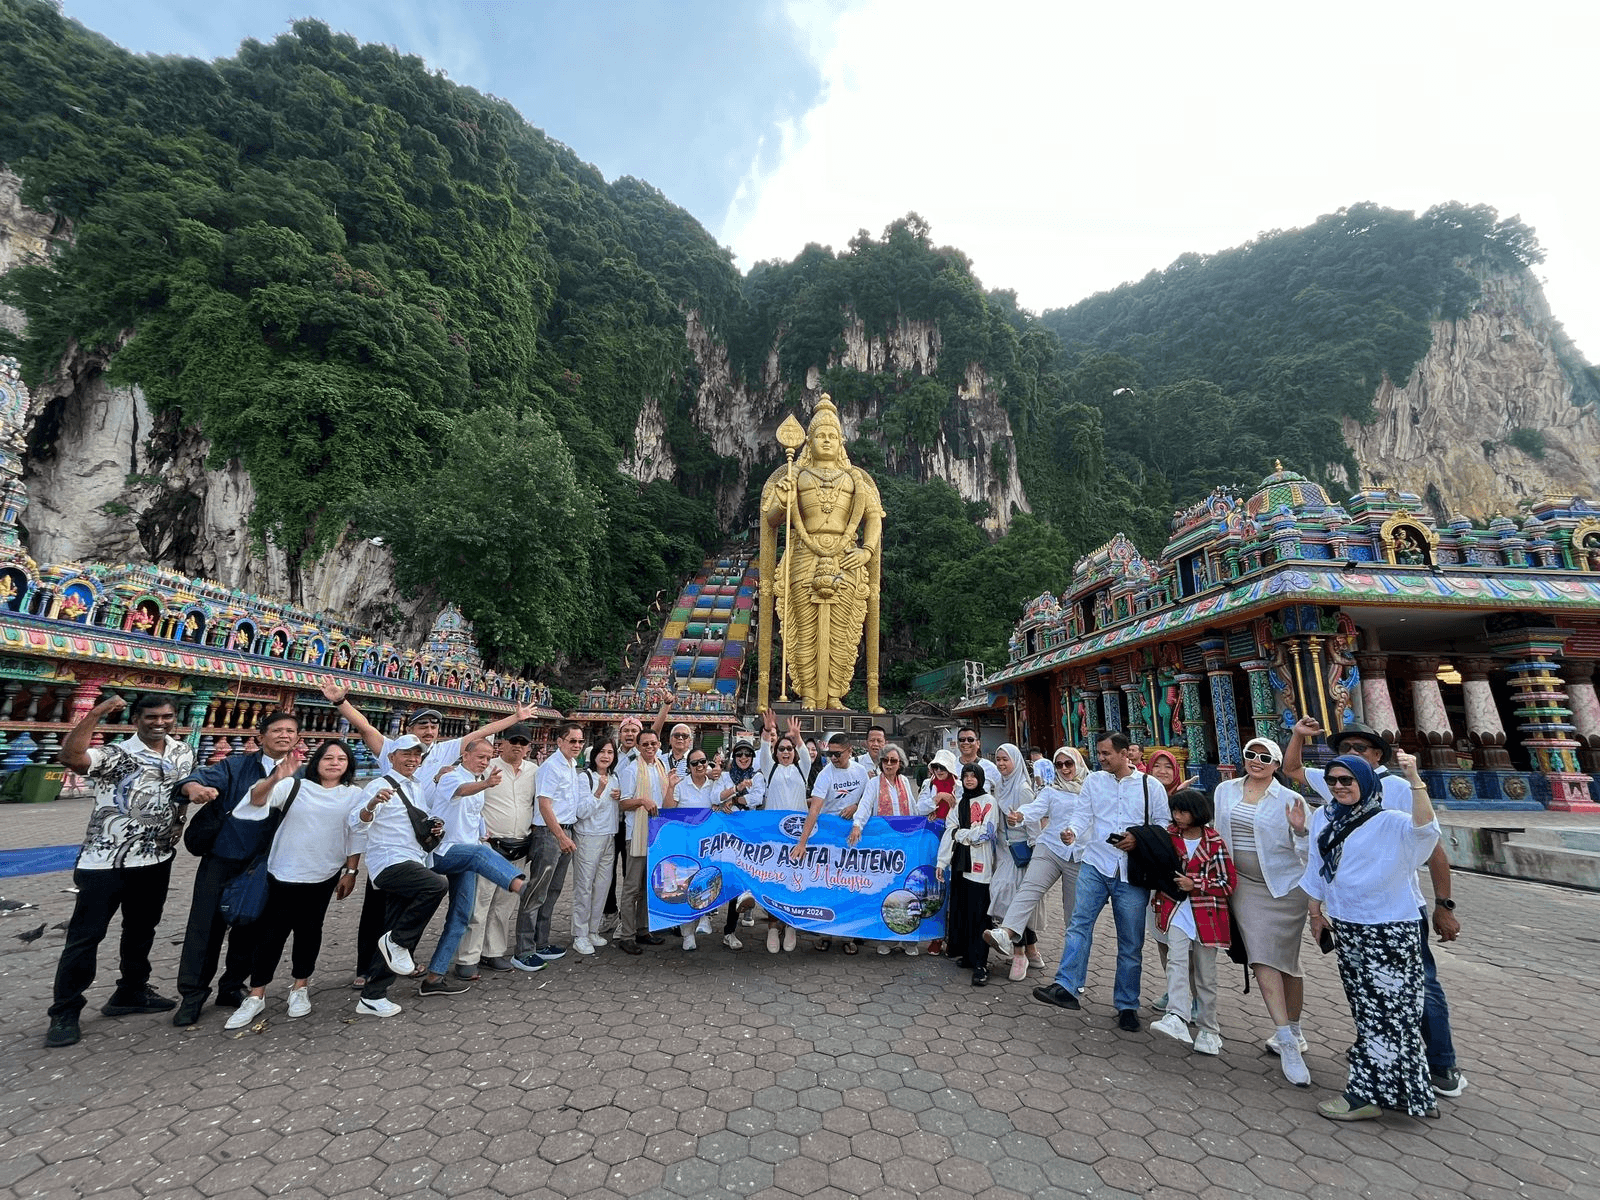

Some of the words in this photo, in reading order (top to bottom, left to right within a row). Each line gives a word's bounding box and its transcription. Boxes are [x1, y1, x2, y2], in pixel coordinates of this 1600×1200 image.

[833, 779, 860, 790] Reebok
[835, 848, 904, 873] JATENG
[811, 863, 873, 892] Malaysia
[791, 907, 806, 916] May
[807, 908, 824, 917] 2024
